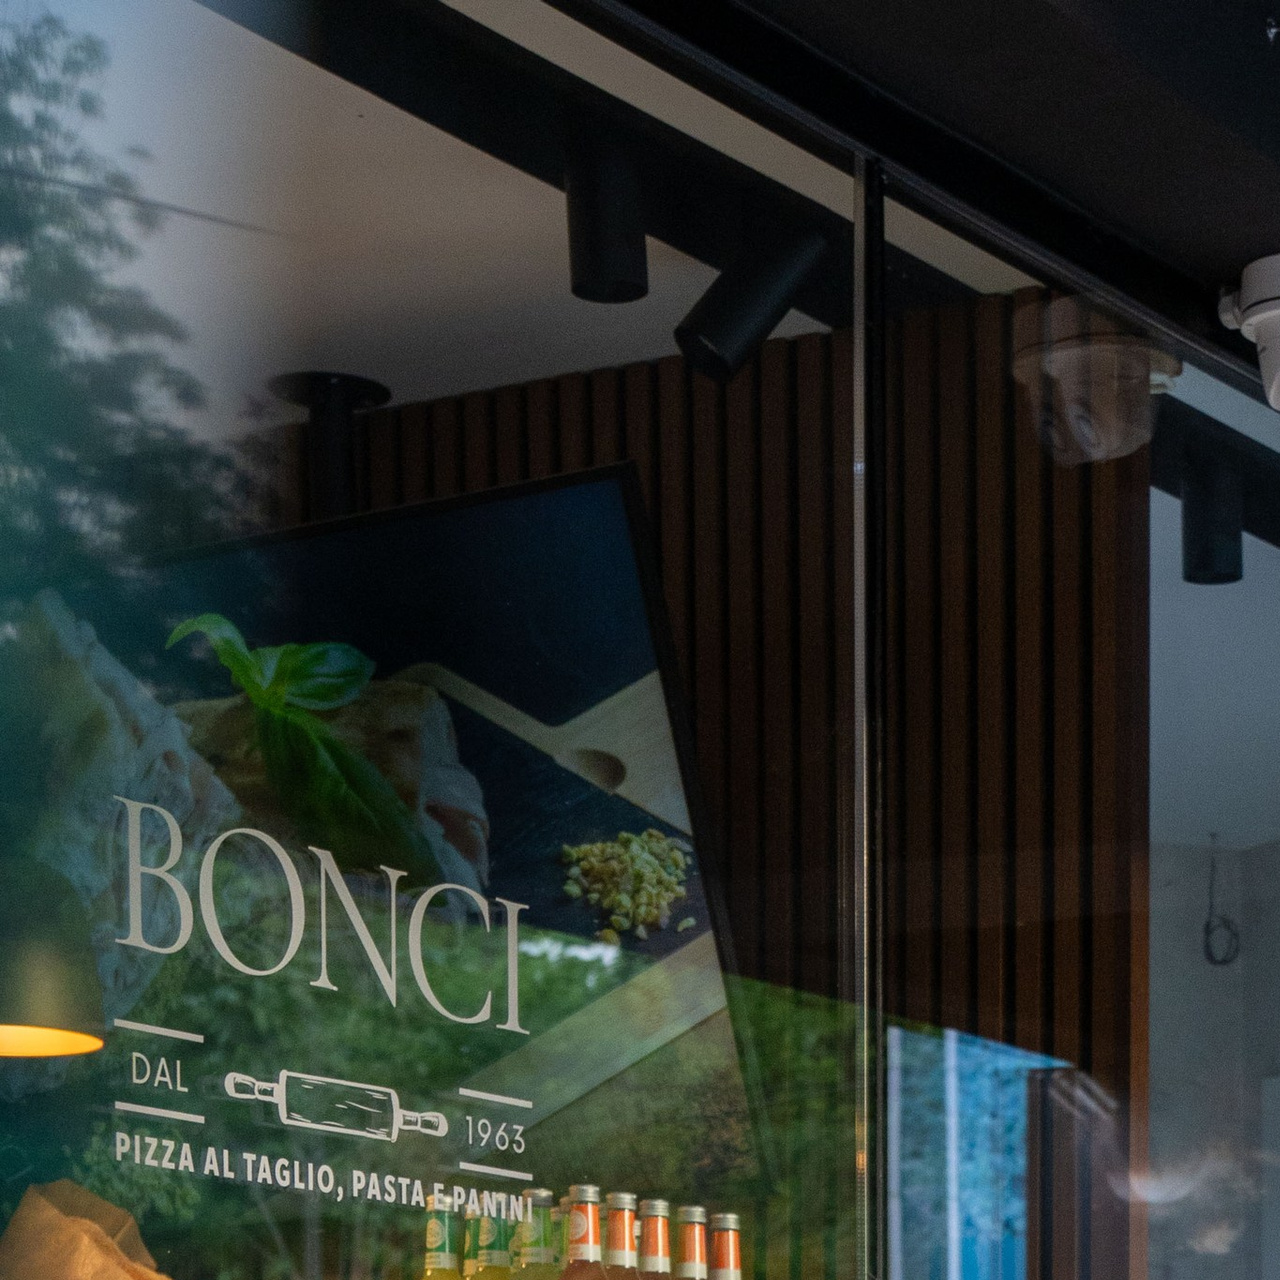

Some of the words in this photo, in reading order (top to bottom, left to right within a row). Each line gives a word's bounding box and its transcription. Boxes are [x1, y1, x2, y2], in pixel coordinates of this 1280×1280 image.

[113, 795, 530, 1035] BONCI
[131, 1051, 188, 1093] DAL
[464, 1115, 526, 1154] 1963
[114, 1131, 195, 1173] PIZZA
[204, 1146, 235, 1180] AL
[242, 1152, 344, 1202] TAGLIO,
[352, 1171, 426, 1208] PASTA
[433, 1183, 445, 1206] E
[453, 1186, 533, 1223] PANINI
